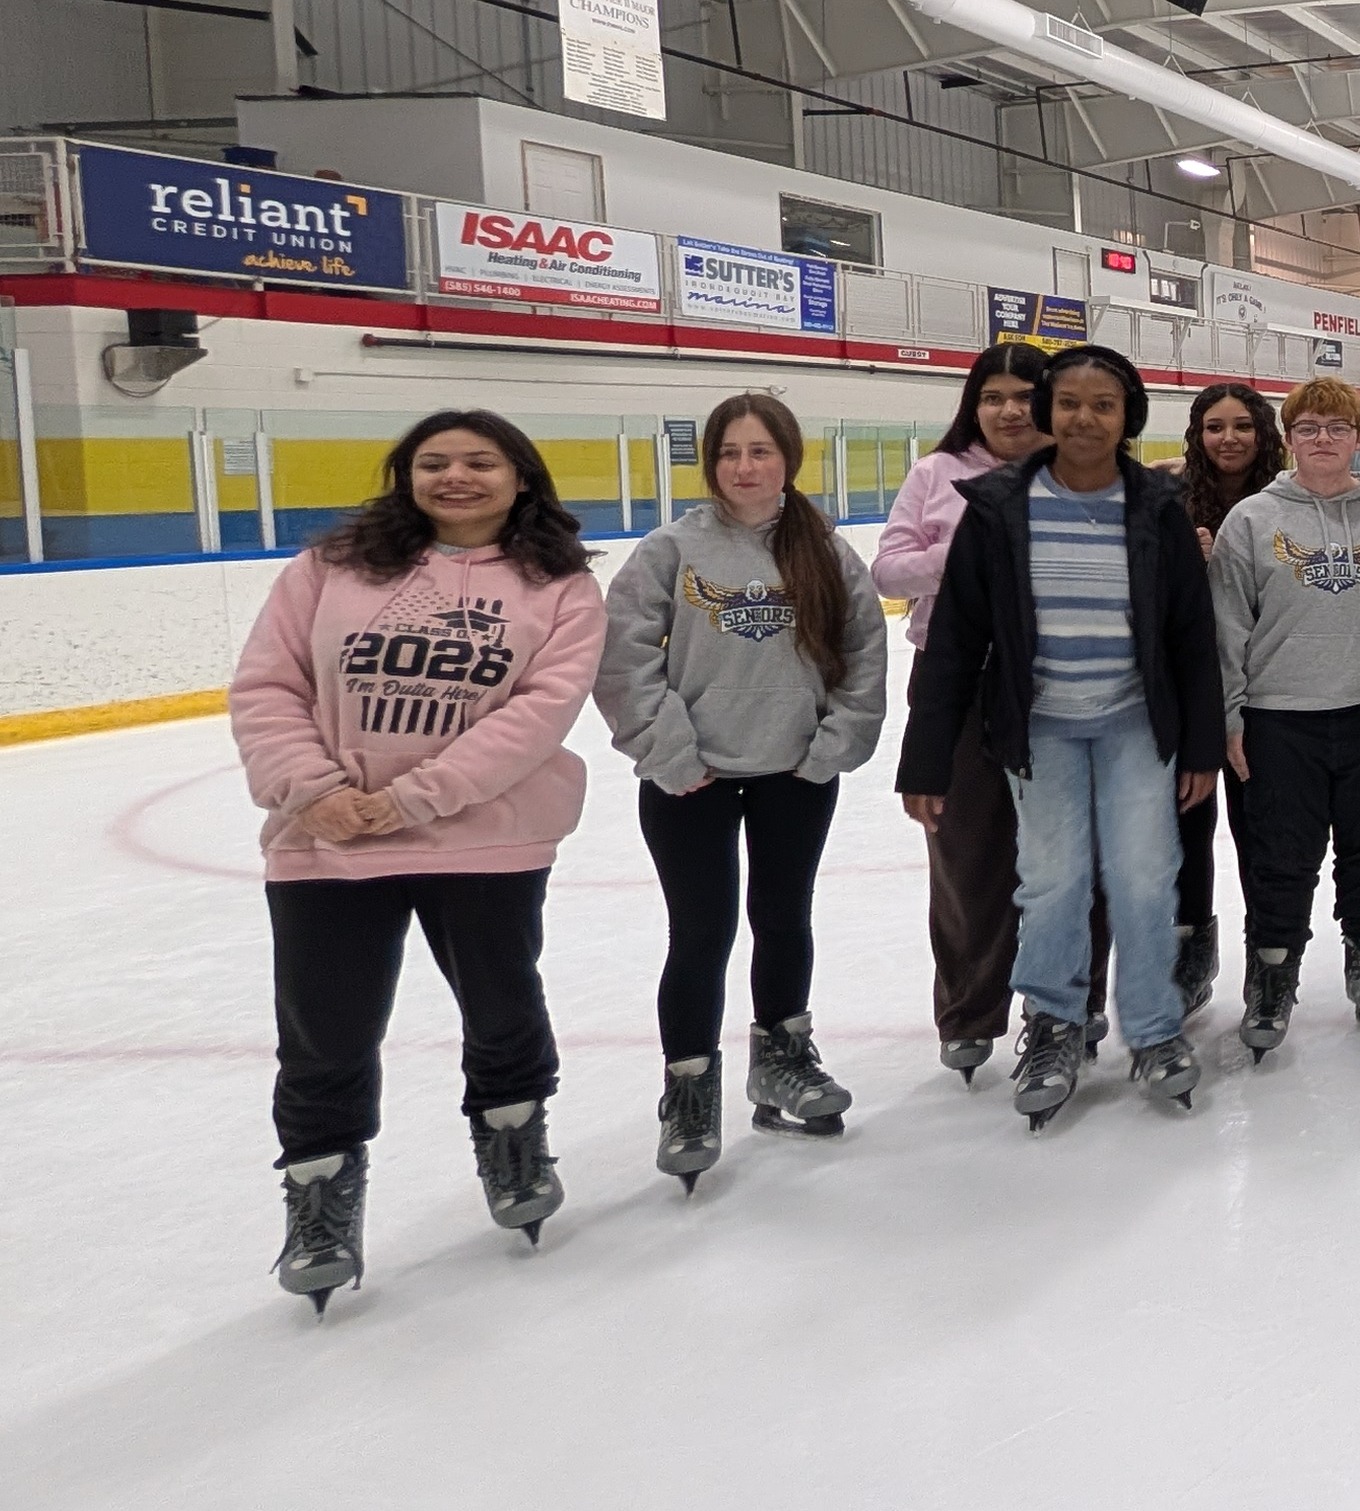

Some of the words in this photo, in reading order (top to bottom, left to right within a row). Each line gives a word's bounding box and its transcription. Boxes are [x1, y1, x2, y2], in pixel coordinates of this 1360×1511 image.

[570, 0, 650, 29] CHAMPIONS
[150, 177, 352, 237] reliant
[152, 217, 257, 242] CREDIT
[272, 231, 353, 254] UNION
[461, 211, 614, 263] ISAAC
[242, 249, 318, 274] achieve
[320, 255, 356, 277] life
[487, 251, 538, 271] Heating
[539, 258, 549, 270] &
[549, 259, 567, 272] Air
[568, 262, 642, 283] Conditioning
[706, 257, 795, 293] SUTTER'S
[445, 280, 471, 293] (585)
[569, 293, 657, 310] ISAACHEATING.COM
[687, 291, 796, 314] marina
[395, 623, 452, 637] CLASS
[340, 632, 514, 688] 2026
[346, 677, 376, 694] I'm
[382, 679, 436, 698] Outta
[440, 685, 488, 705] Here!
